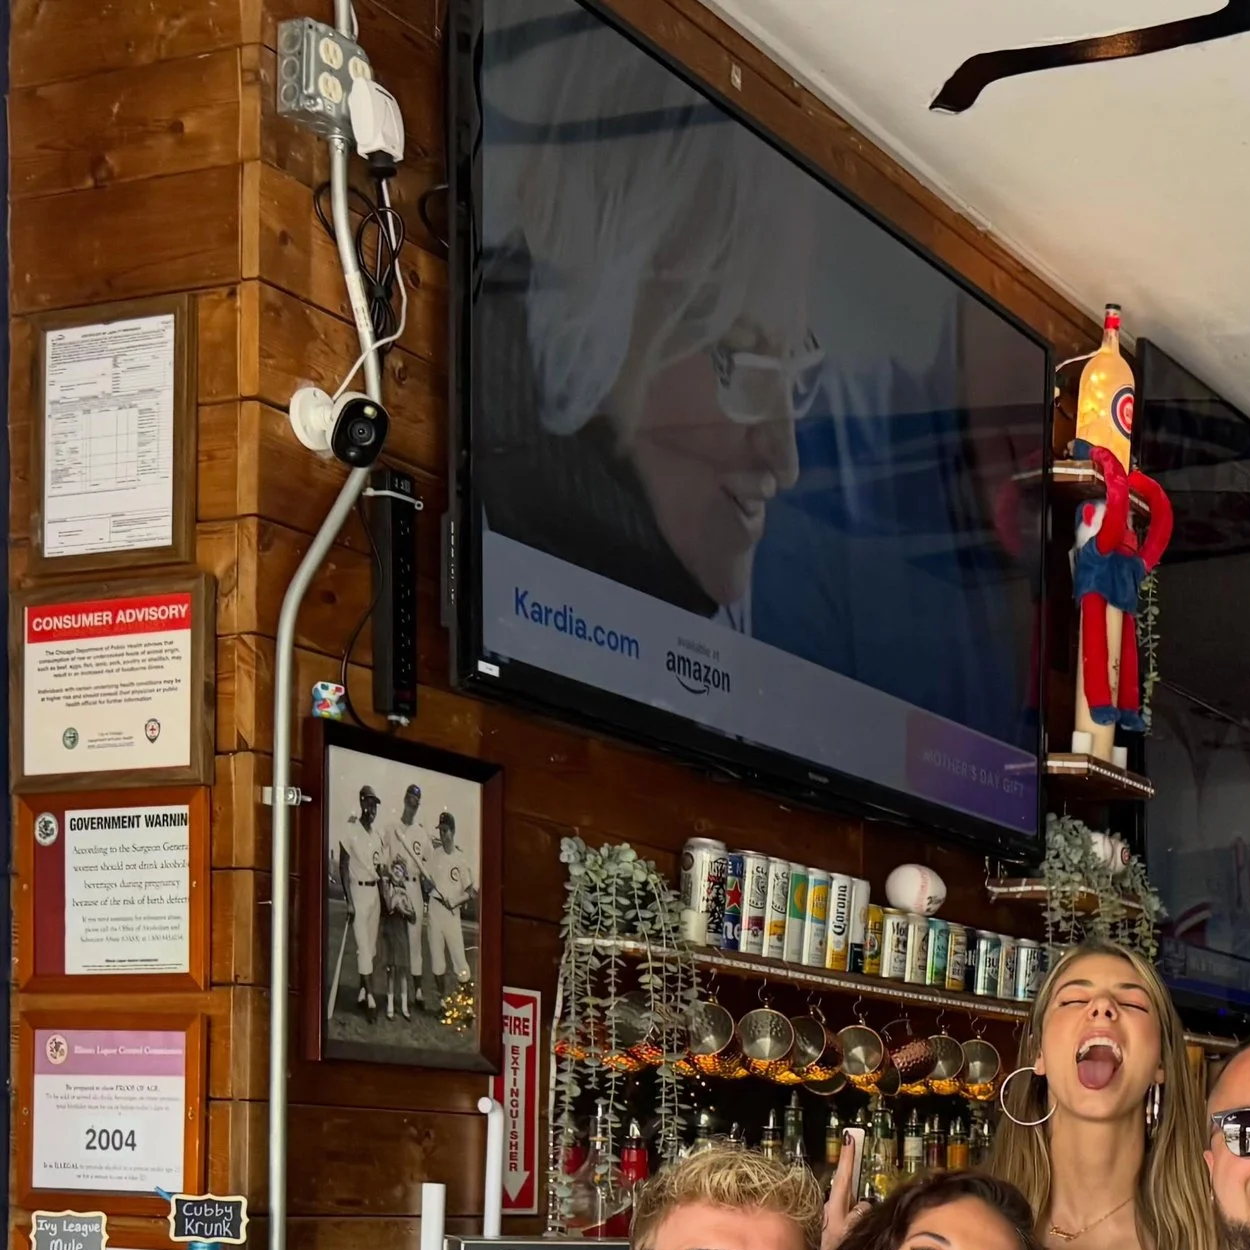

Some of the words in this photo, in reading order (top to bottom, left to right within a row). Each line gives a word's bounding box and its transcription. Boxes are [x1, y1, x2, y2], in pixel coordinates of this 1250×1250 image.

[32, 611, 112, 632] CONSUMER
[116, 604, 189, 624] ADVISORY
[514, 586, 640, 660] Kardia.com
[666, 650, 730, 692] amazon
[980, 767, 1000, 788] DAY
[1002, 777, 1024, 798] GIFT
[70, 815, 141, 831] GOVERNMENT
[144, 813, 188, 828] WARNIN
[72, 844, 108, 855] According
[119, 844, 130, 852] the
[132, 844, 160, 854] Surgeon
[162, 842, 188, 851] Genera
[73, 864, 98, 872] women
[100, 862, 124, 871] should
[138, 860, 158, 870] drink
[160, 860, 188, 869] alcohol
[84, 880, 118, 890] beverages
[120, 878, 142, 889] during
[144, 880, 180, 890] pregnancy
[72, 898, 98, 907] because
[110, 896, 120, 906] the
[166, 894, 188, 904] defect
[503, 1016, 530, 1036] FIRE
[509, 1046, 520, 1172] EXTINGUISHER
[85, 1128, 136, 1151] 2004
[182, 1202, 233, 1221] Cubby
[37, 1220, 58, 1236] Ivy
[63, 1219, 101, 1236] League
[184, 1218, 233, 1237] Krunk
